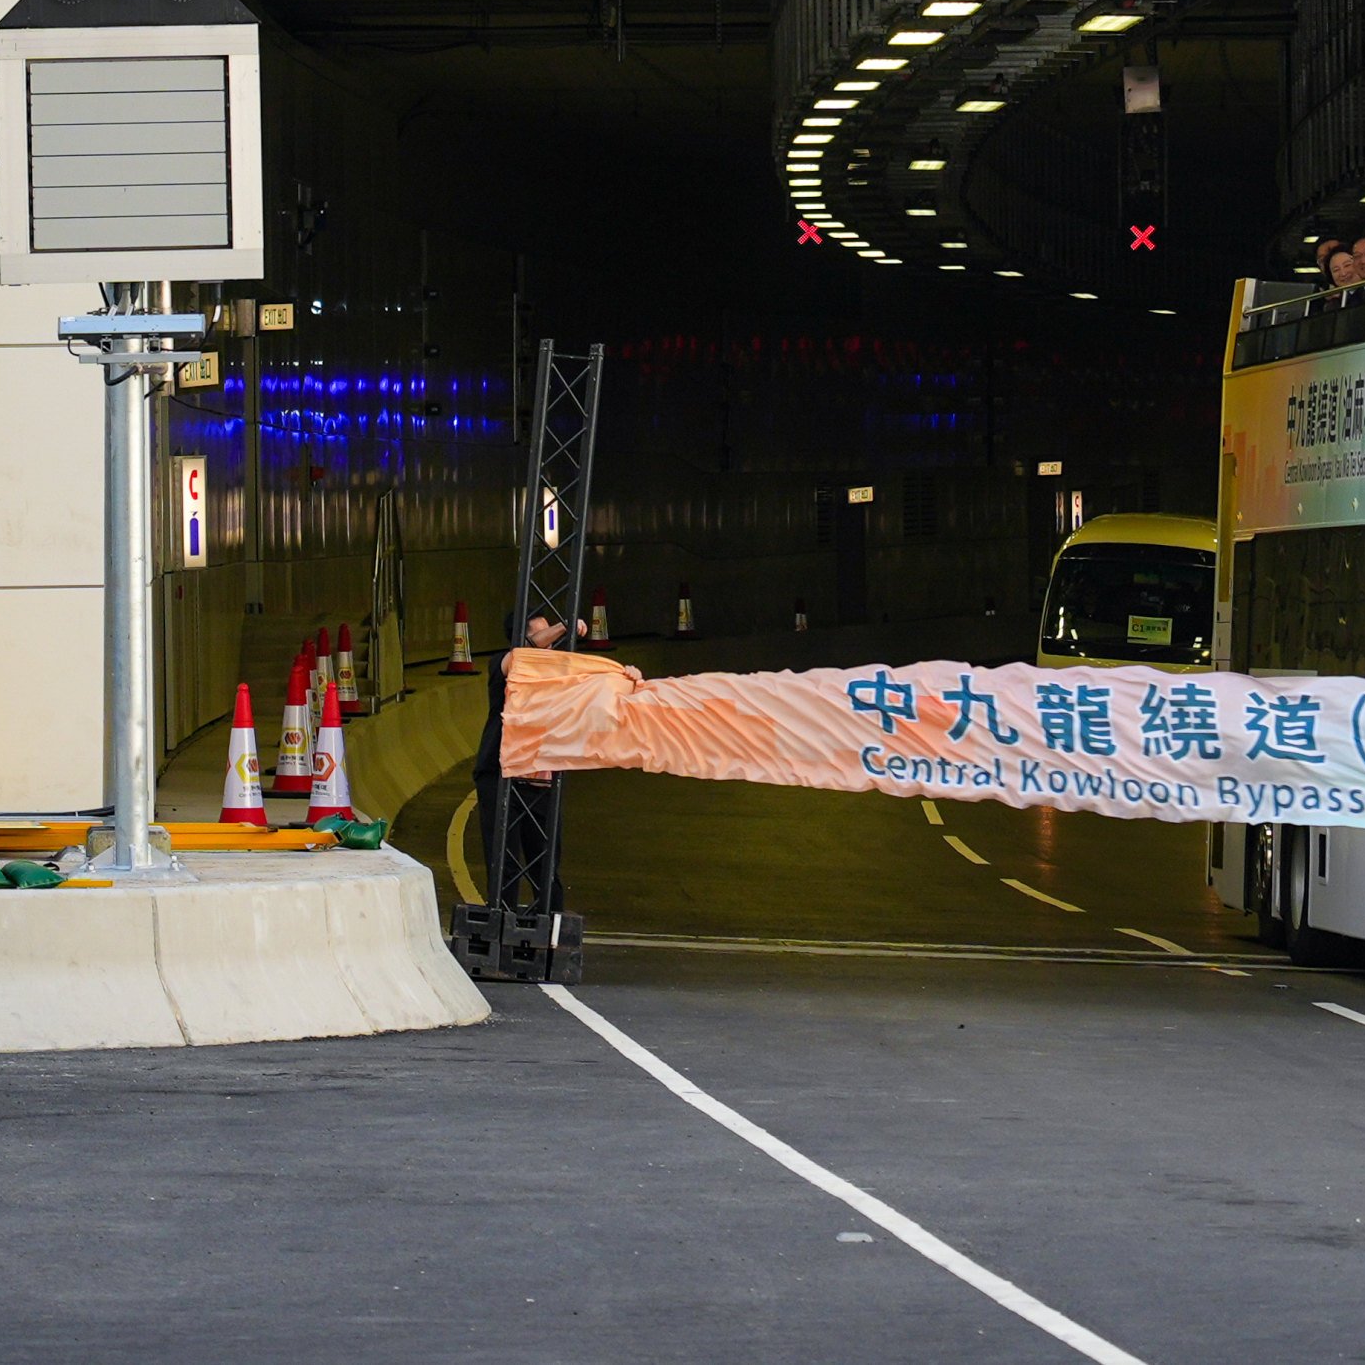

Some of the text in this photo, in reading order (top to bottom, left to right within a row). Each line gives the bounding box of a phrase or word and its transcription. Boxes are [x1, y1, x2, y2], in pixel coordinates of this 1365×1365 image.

[861, 743, 1005, 788] Central
[1020, 761, 1200, 807] Kowloon
[1217, 778, 1364, 819] Bypass
